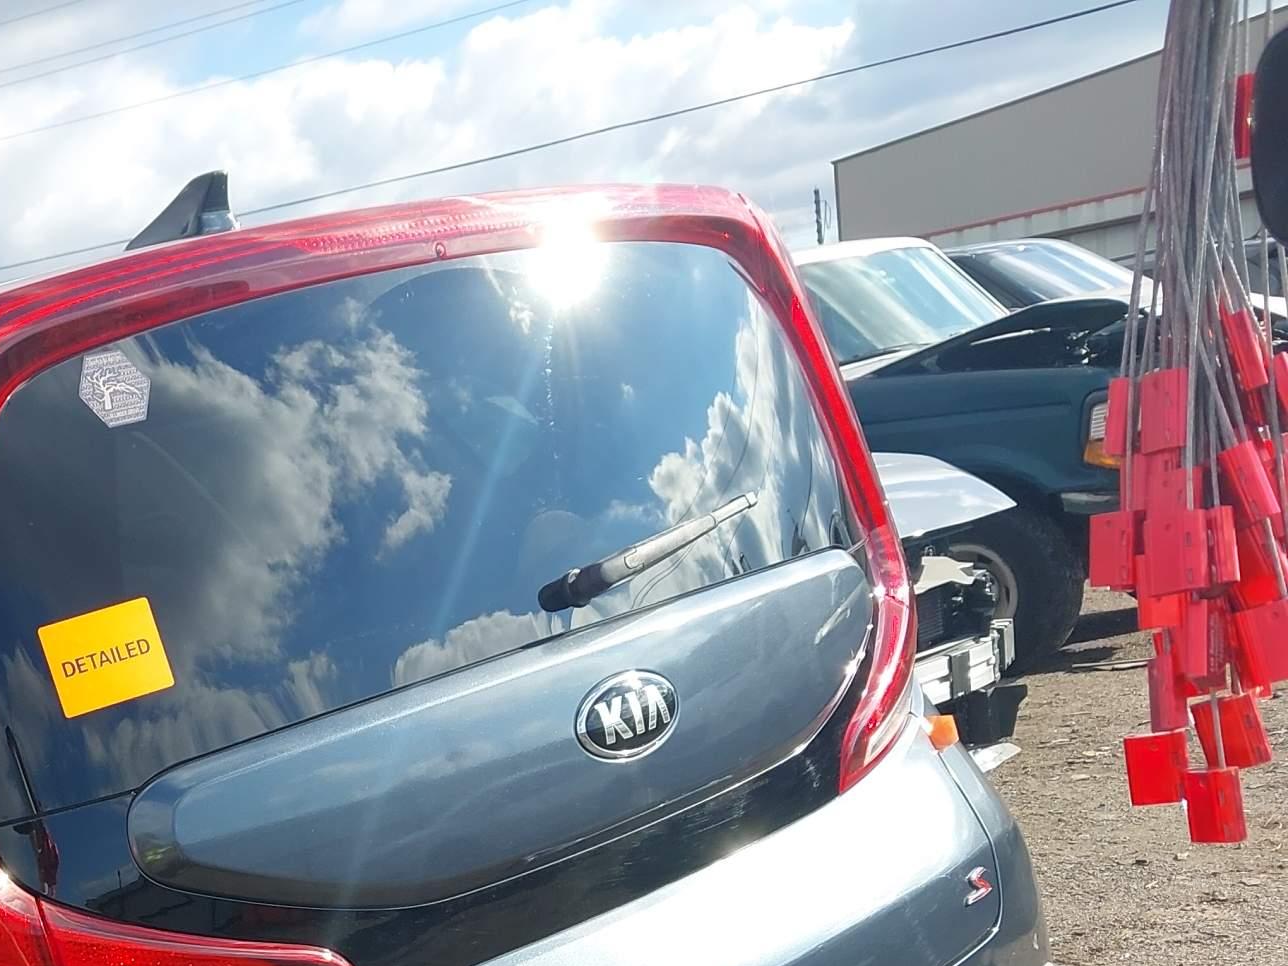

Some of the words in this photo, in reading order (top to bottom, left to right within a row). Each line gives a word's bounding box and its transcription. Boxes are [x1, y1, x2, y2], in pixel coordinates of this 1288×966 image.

[61, 638, 151, 678] DETAILED
[593, 683, 671, 745] KIA
[964, 865, 993, 906] S
